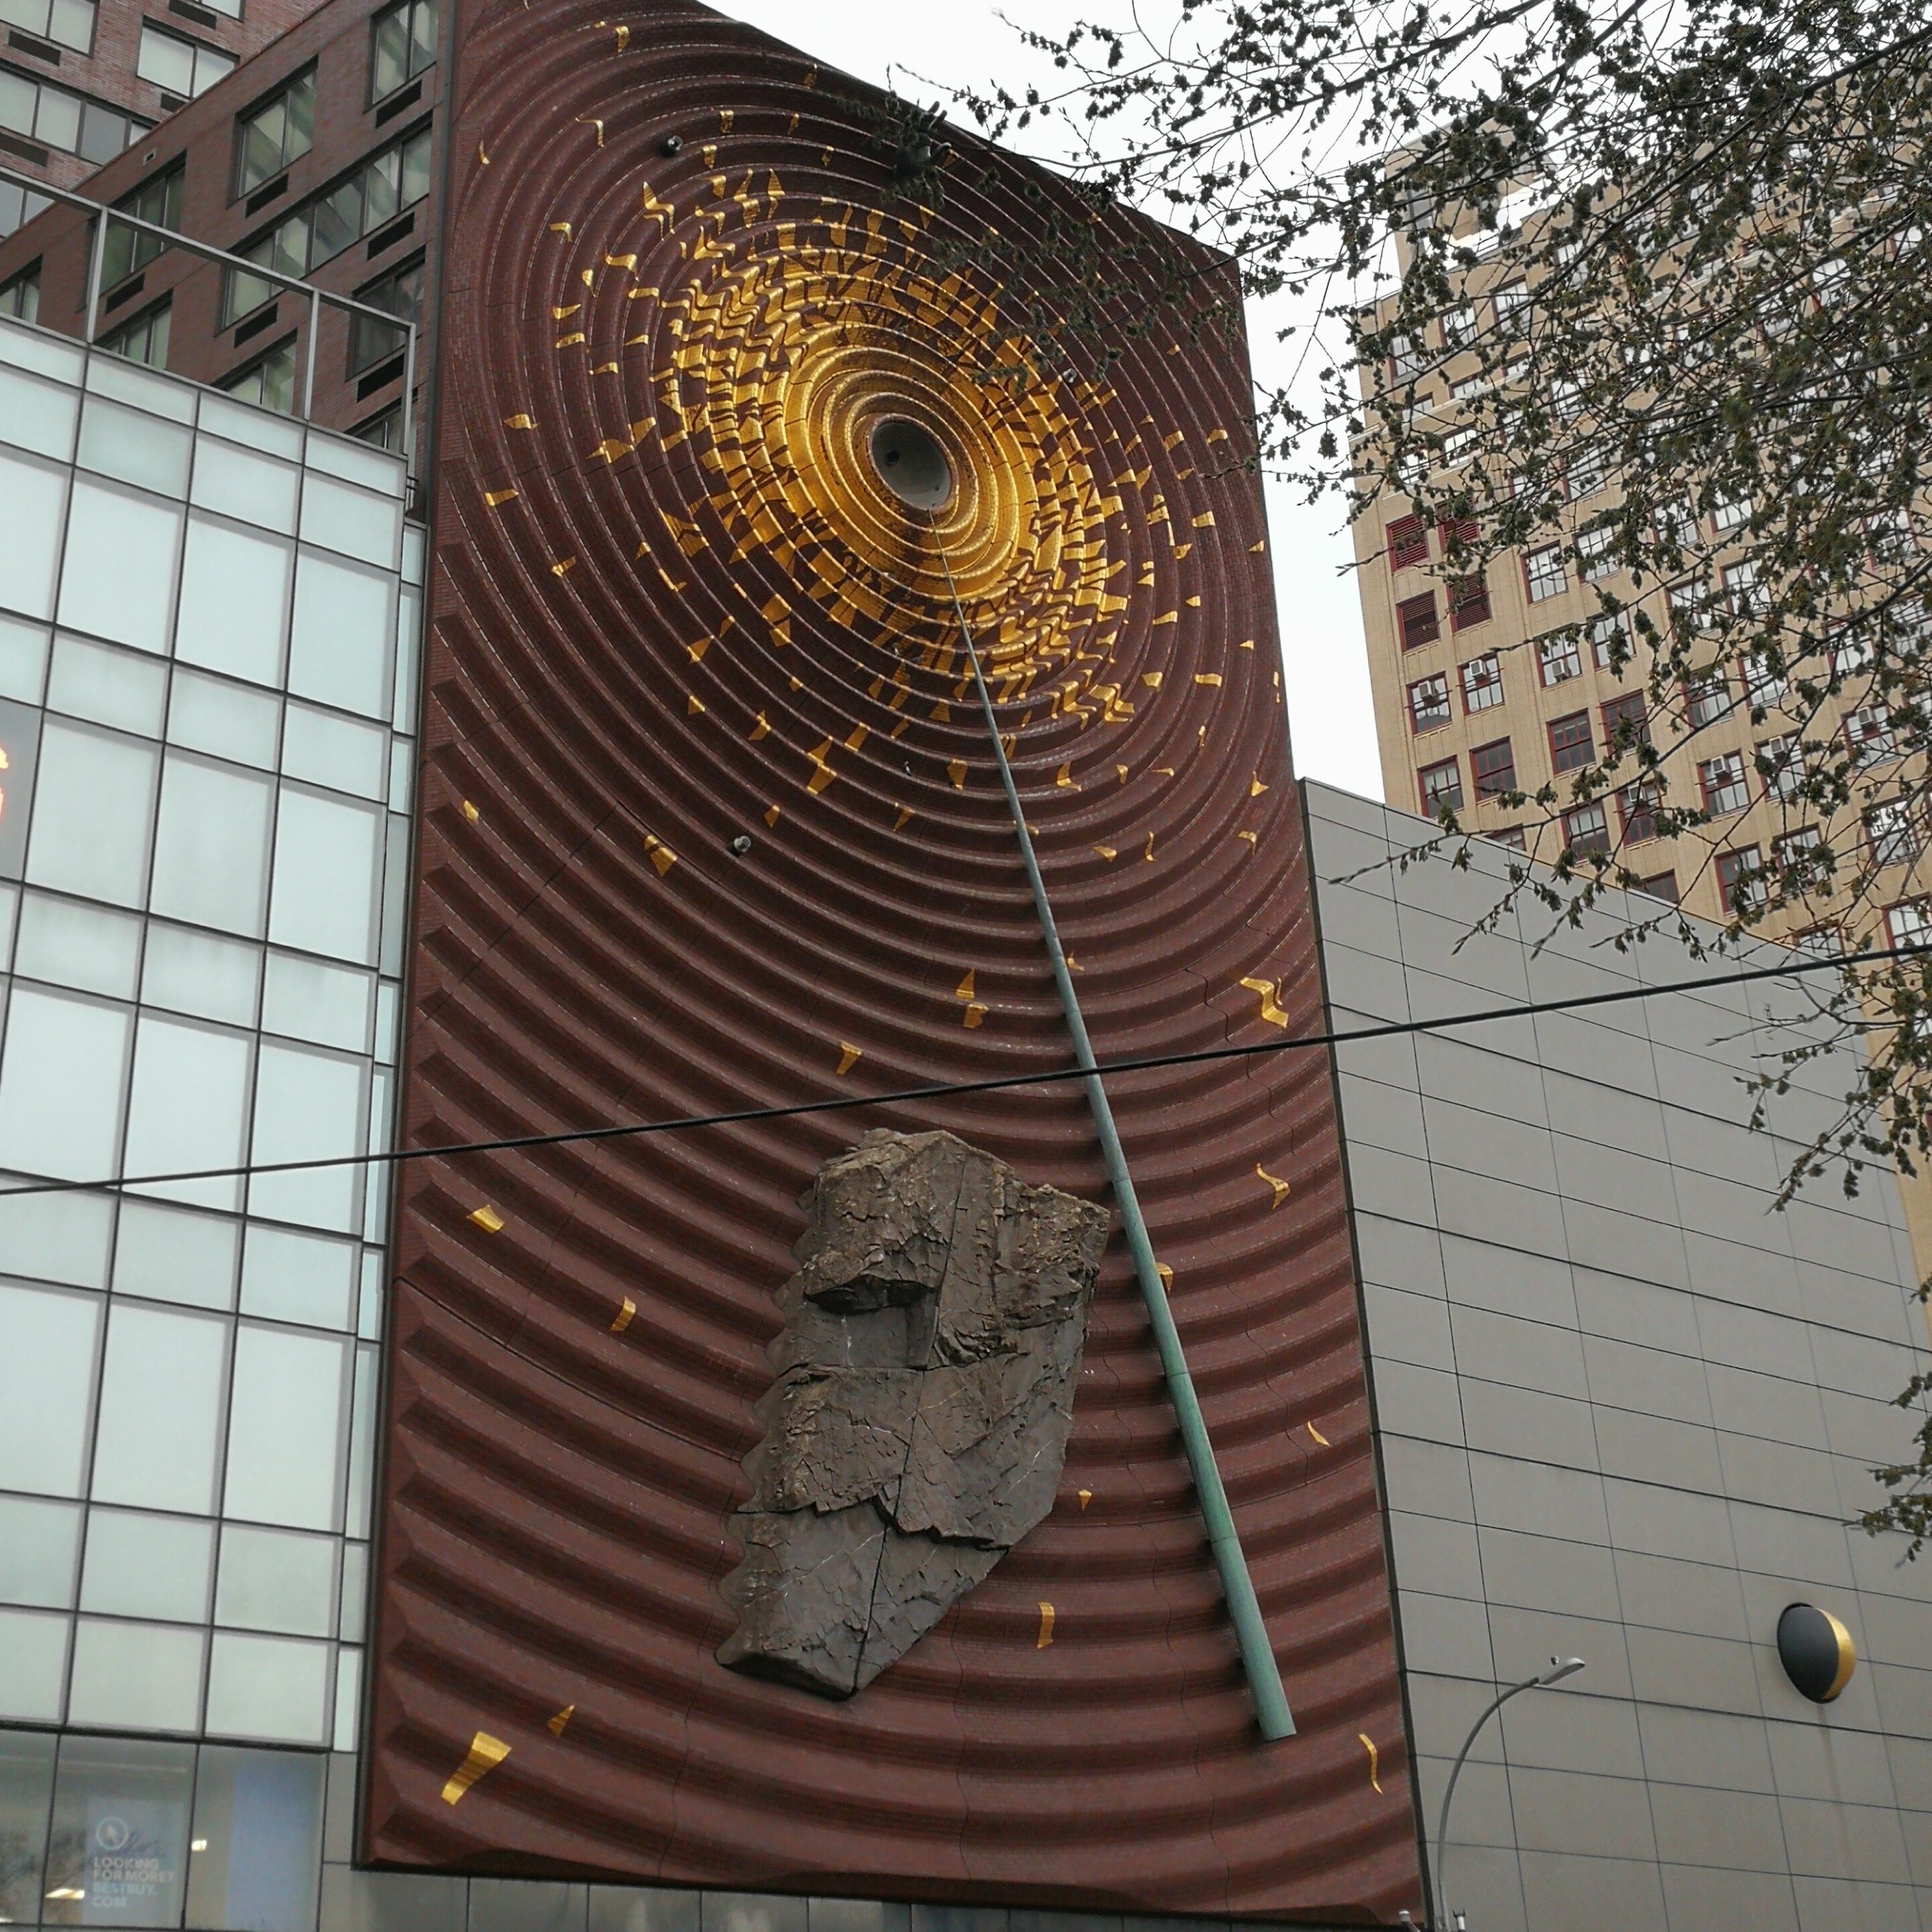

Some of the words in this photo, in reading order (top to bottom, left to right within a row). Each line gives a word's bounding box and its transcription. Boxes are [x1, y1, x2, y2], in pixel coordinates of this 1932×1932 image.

[93, 1856, 160, 1870] LOOKING
[93, 1869, 122, 1880] FOR
[125, 1870, 174, 1882] MORE?
[93, 1895, 126, 1907] COM
